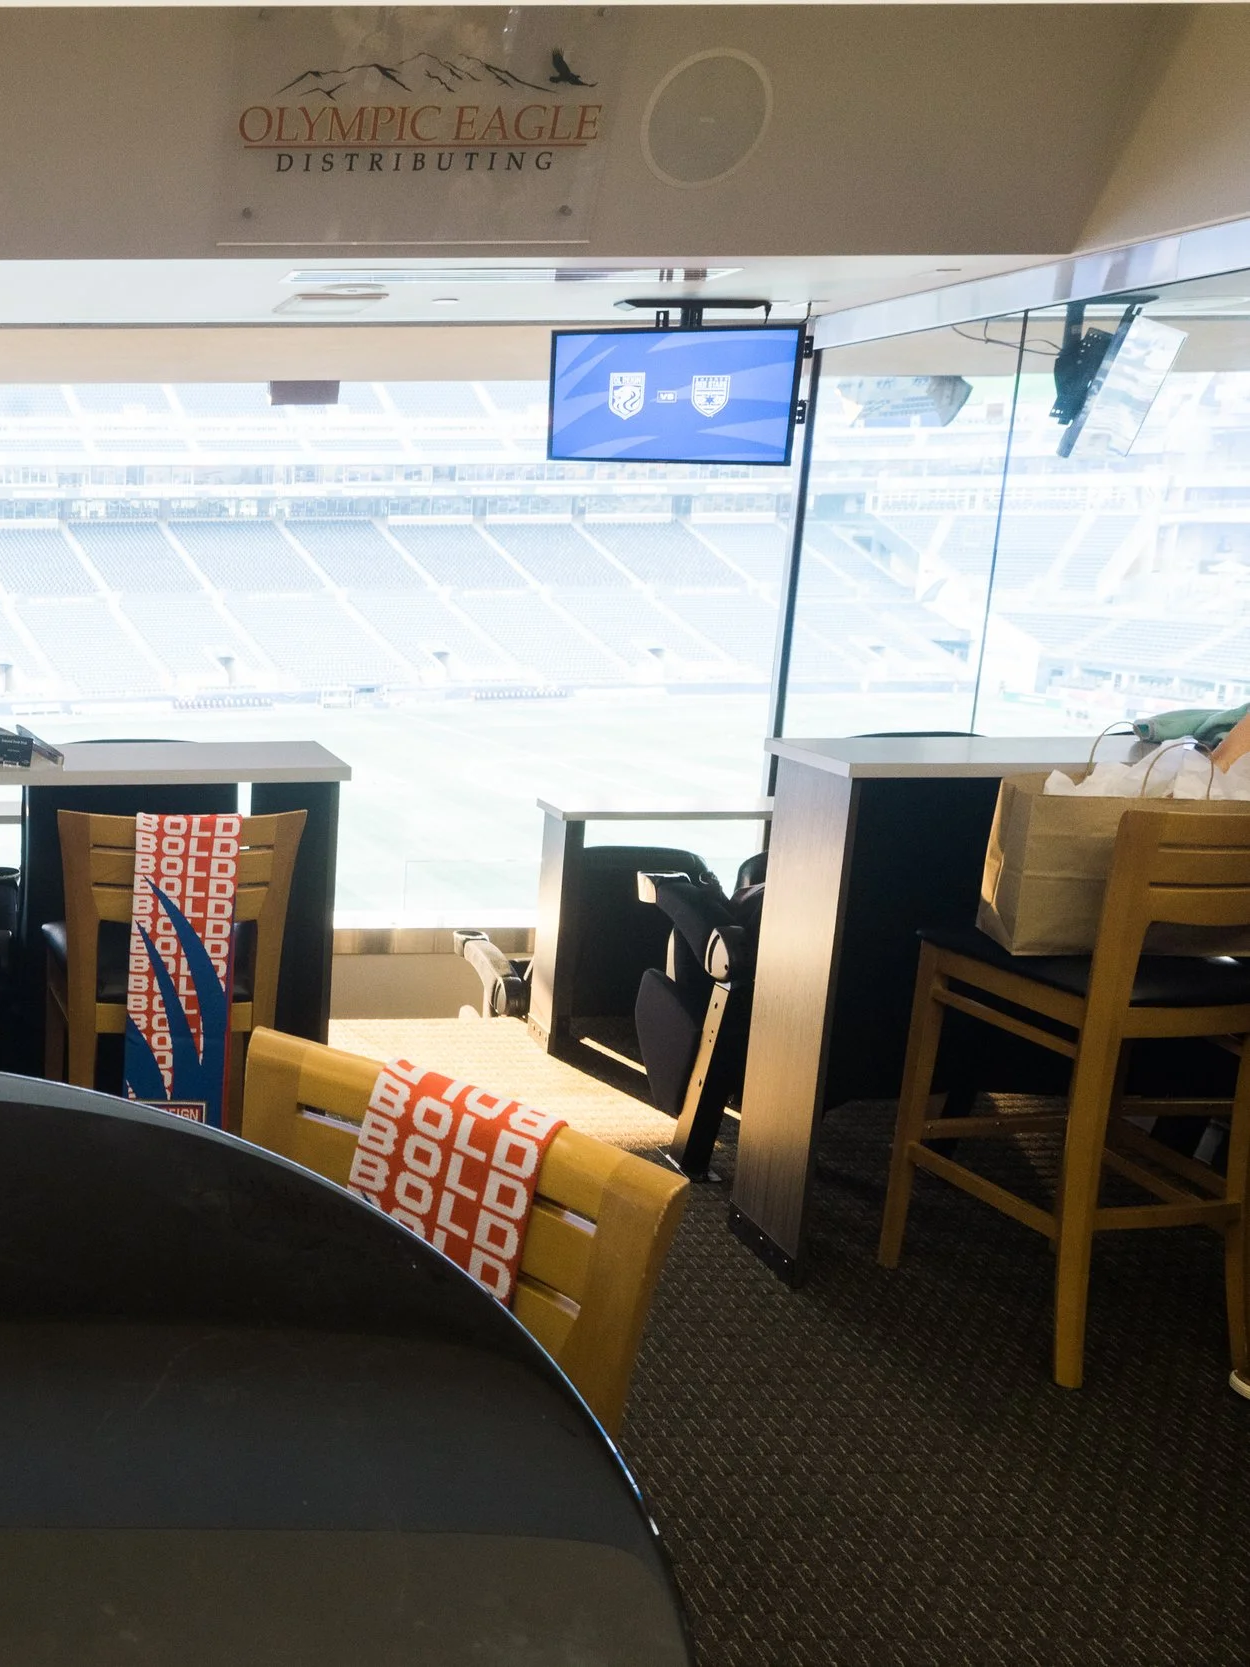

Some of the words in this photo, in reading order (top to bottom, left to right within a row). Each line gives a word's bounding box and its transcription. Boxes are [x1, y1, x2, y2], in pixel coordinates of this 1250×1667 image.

[238, 105, 442, 144] OLYMPIC
[452, 103, 603, 142] EAGLE
[275, 151, 554, 173] DISTRIBUTING
[136, 813, 240, 837] BOLD
[135, 831, 238, 858] BOLD
[134, 853, 236, 878] BOLD
[133, 874, 235, 899] BOLD
[368, 1071, 539, 1179] BOLD
[358, 1111, 528, 1220] BOLD
[349, 1147, 519, 1261] BOLD
